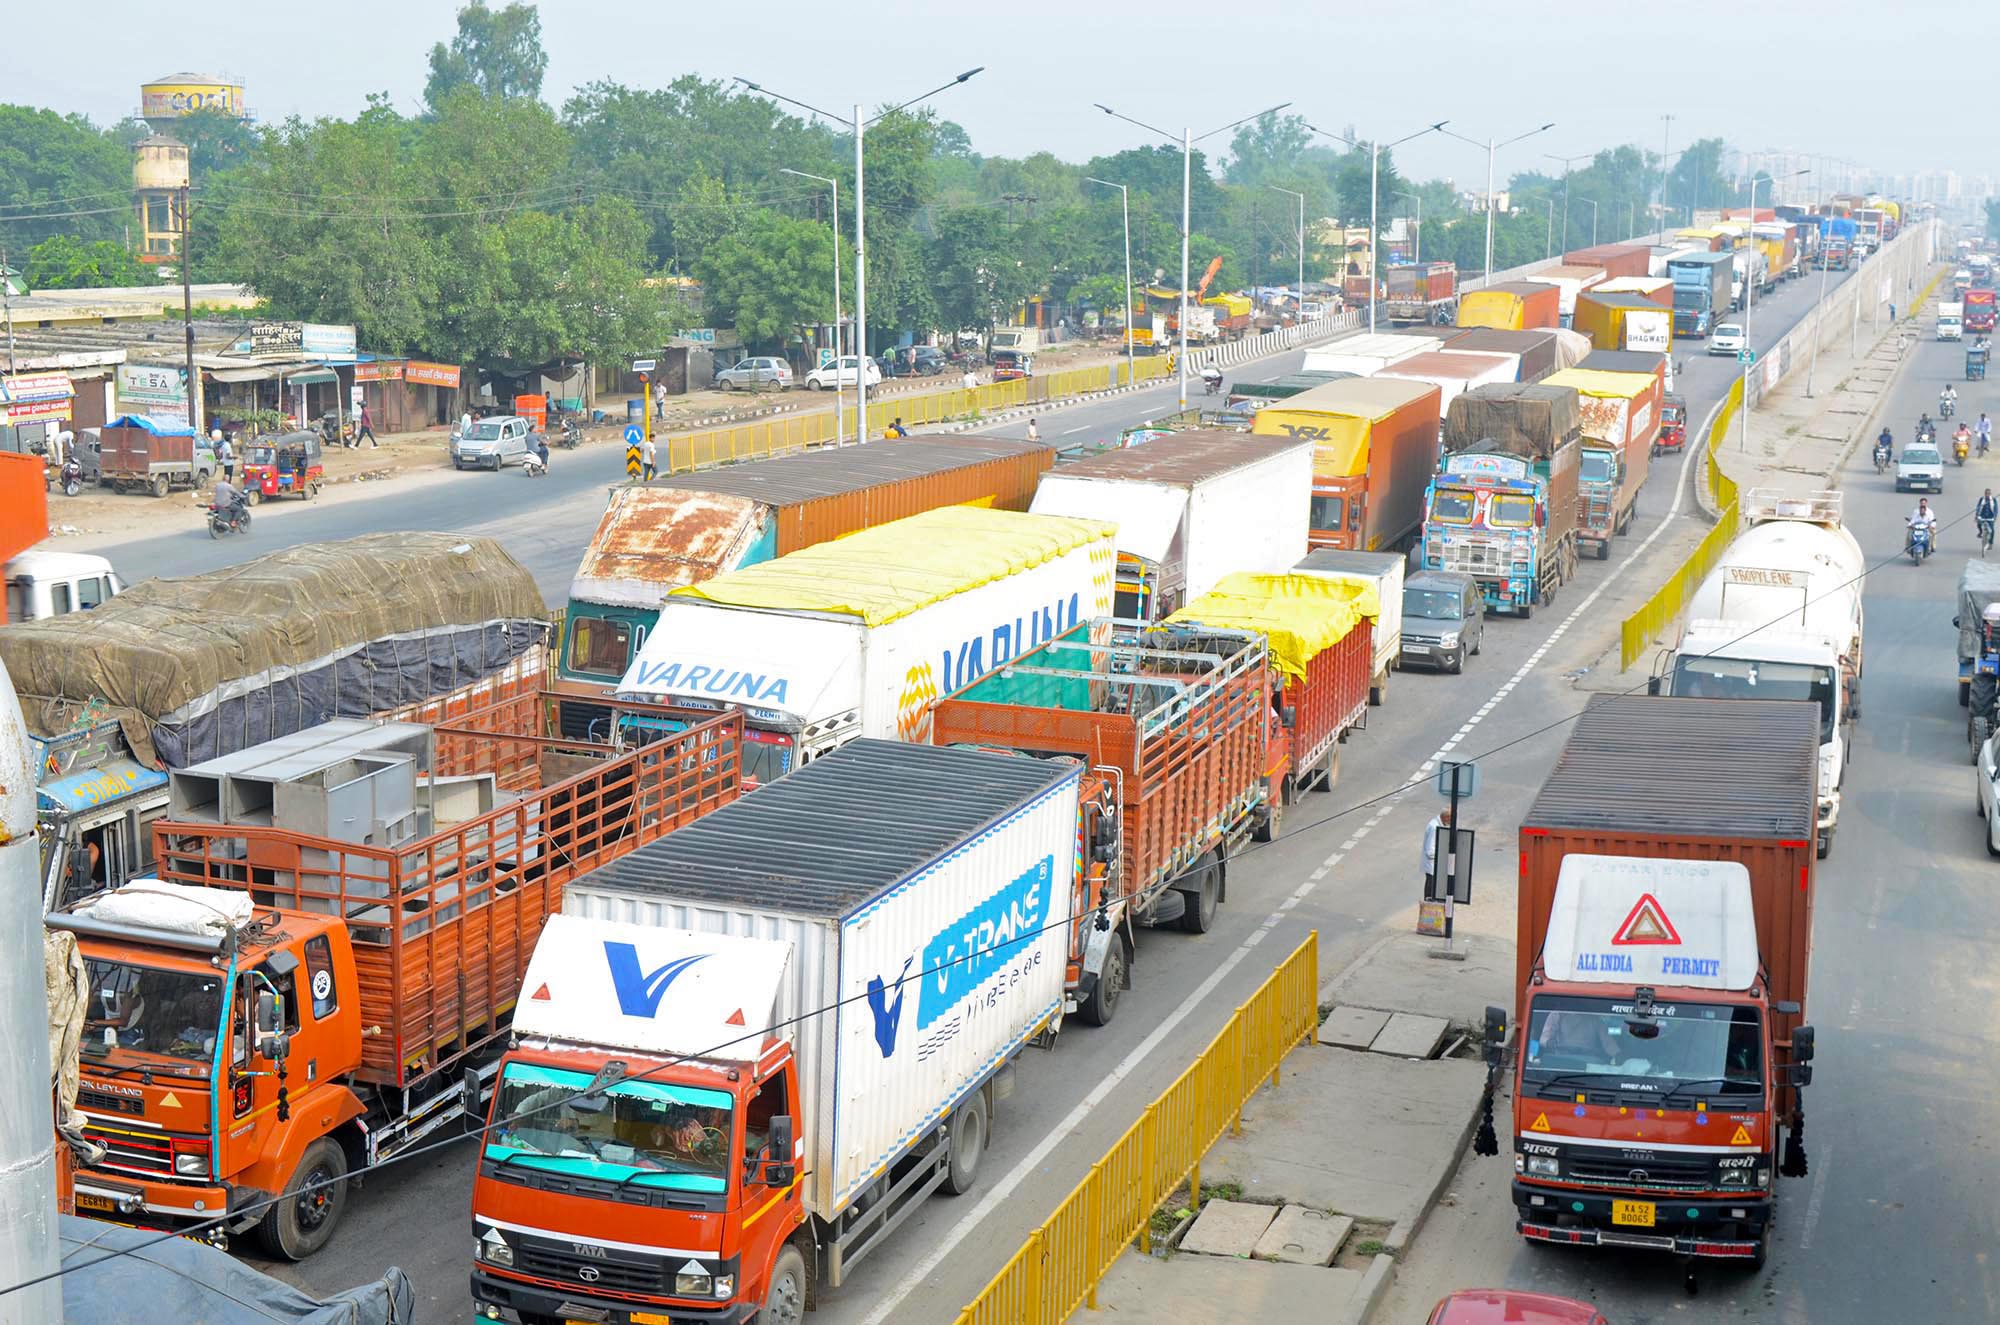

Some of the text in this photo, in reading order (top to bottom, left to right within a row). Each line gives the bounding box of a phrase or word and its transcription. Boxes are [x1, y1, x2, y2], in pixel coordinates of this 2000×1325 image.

[130, 376, 167, 388] TESA
[1279, 424, 1333, 441] VRL
[1731, 568, 1793, 586] PROPYLENE
[637, 661, 788, 704] VARUNA
[1577, 954, 1720, 976] ALL INDIA PERMIT
[96, 1082, 143, 1097] LEYLAND
[1621, 1148, 1655, 1160] TATA
[1624, 1204, 1649, 1214] KA 52
[573, 1243, 607, 1258] TATA
